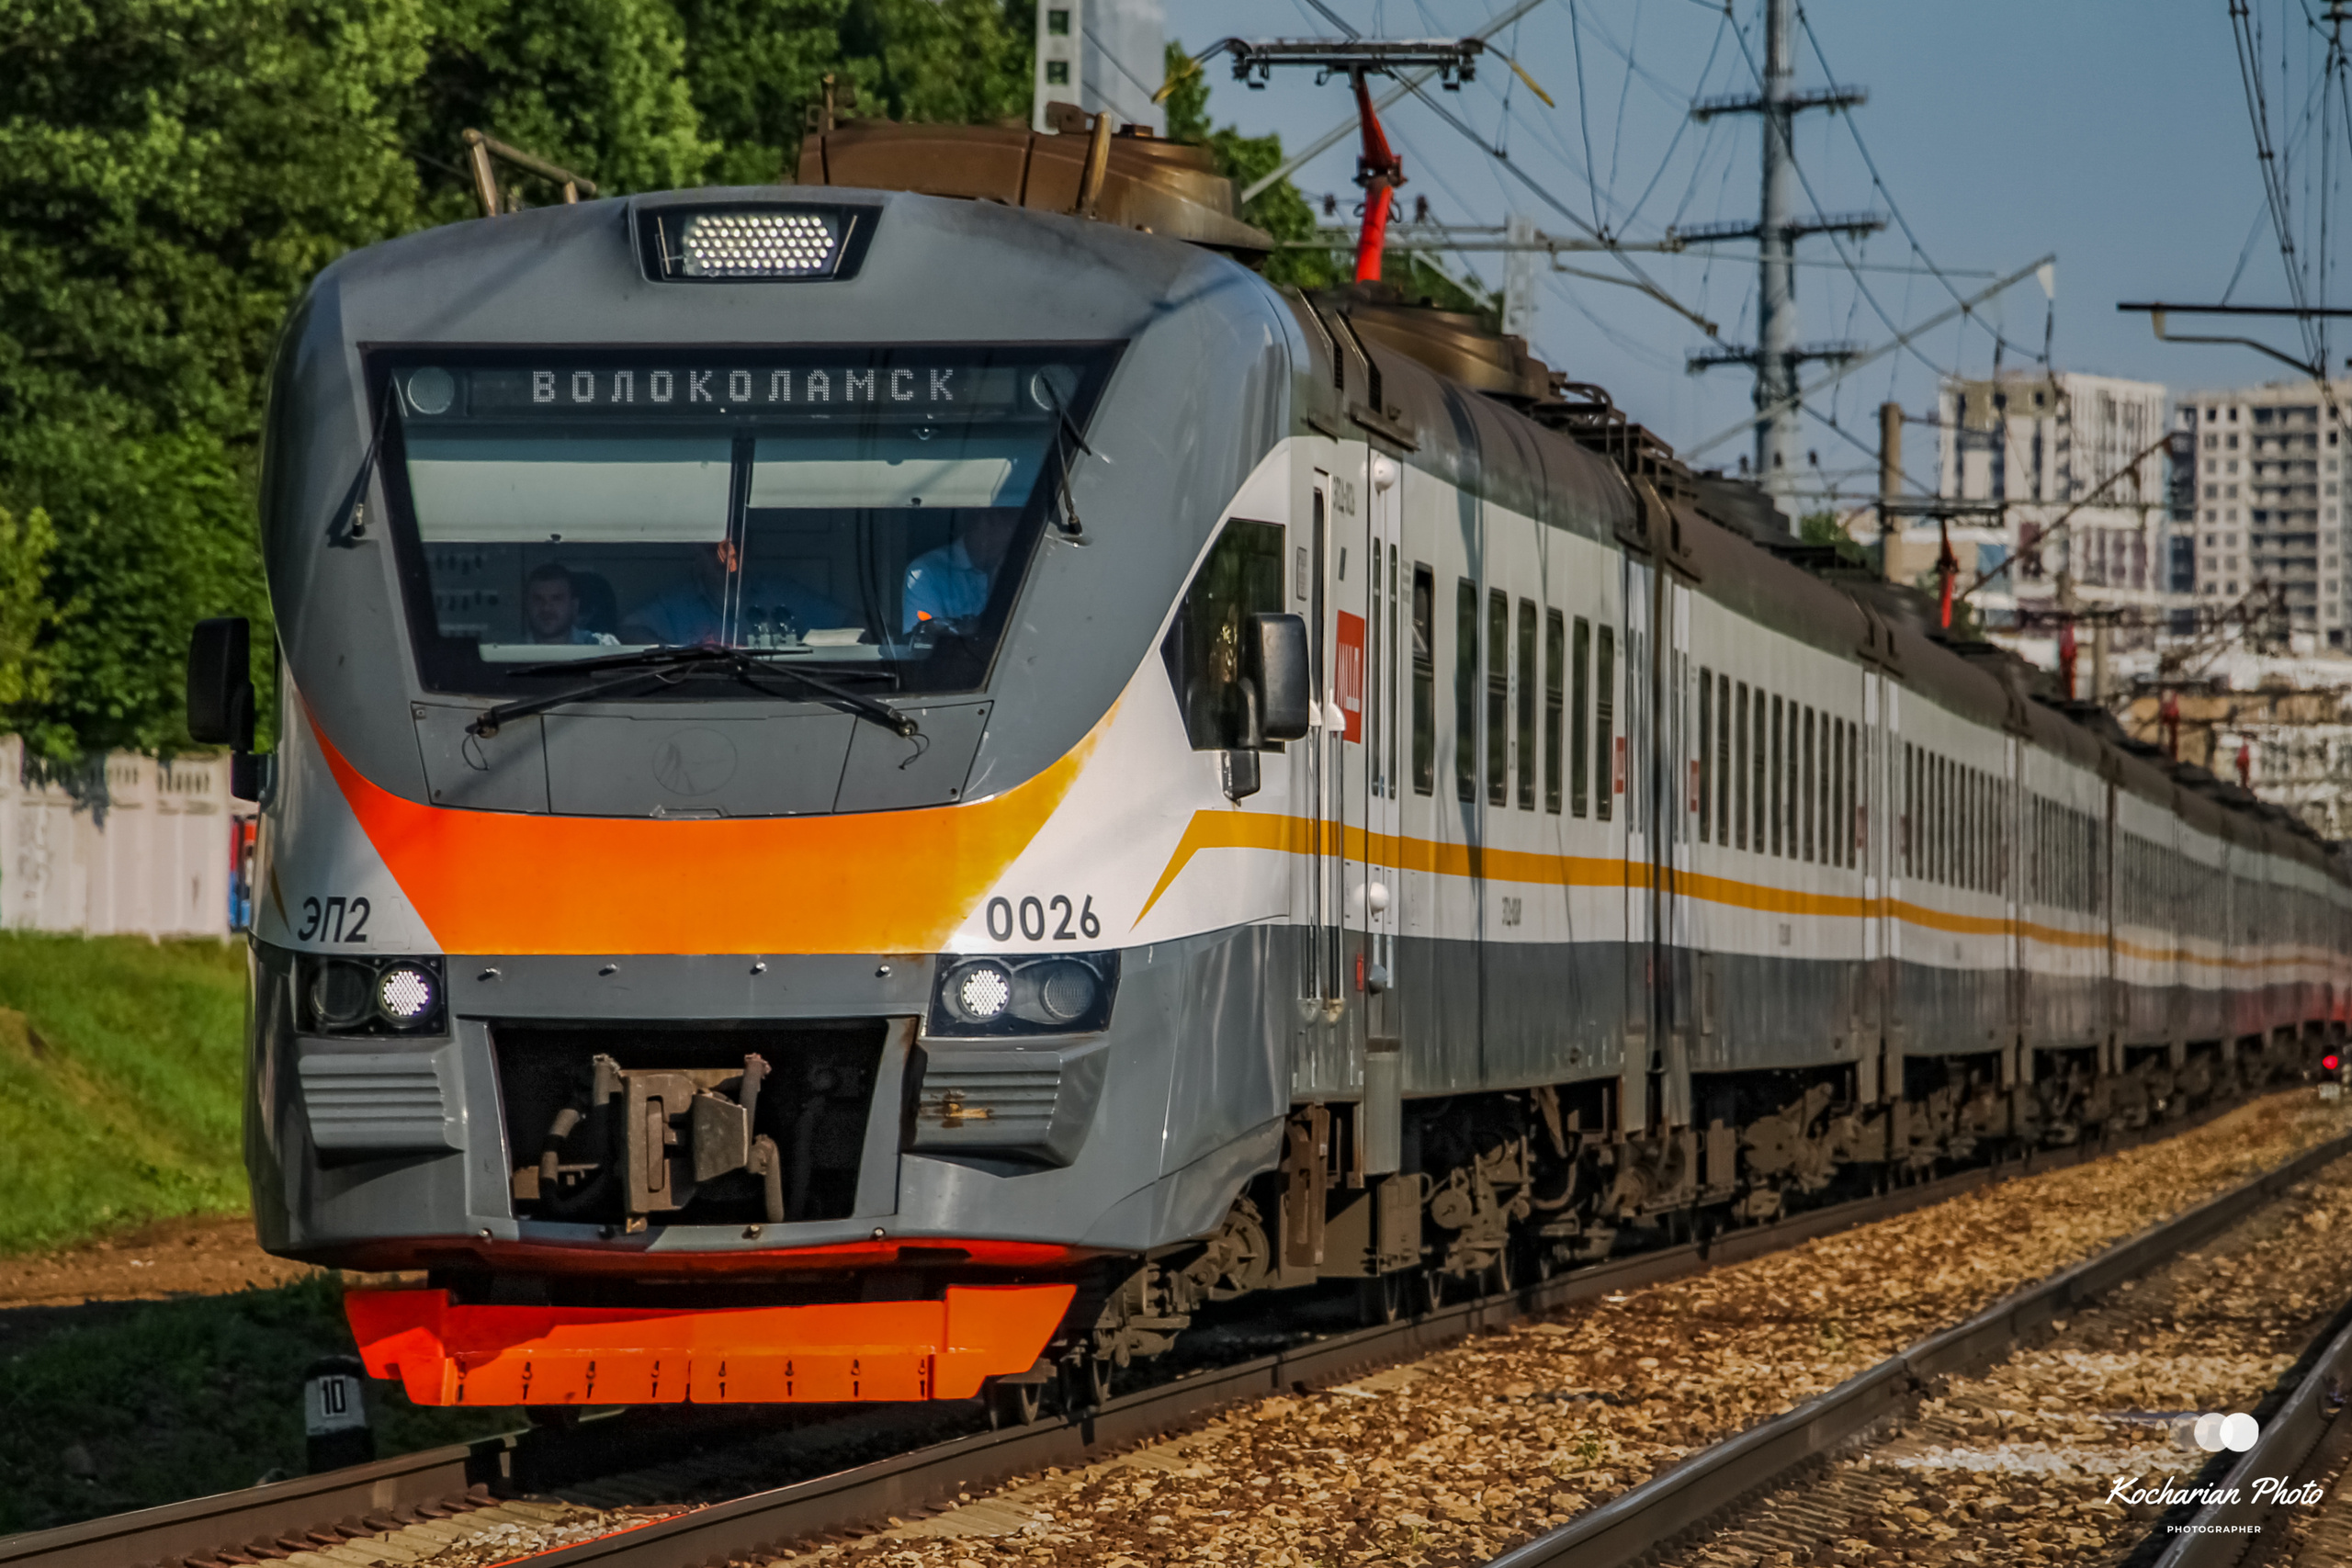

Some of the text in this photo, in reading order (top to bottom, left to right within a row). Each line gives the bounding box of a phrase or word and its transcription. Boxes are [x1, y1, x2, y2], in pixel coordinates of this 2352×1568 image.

[532, 368, 954, 403] ВОЛОКОЛАМСК
[986, 894, 1101, 942] 0026
[322, 1379, 346, 1415] 10
